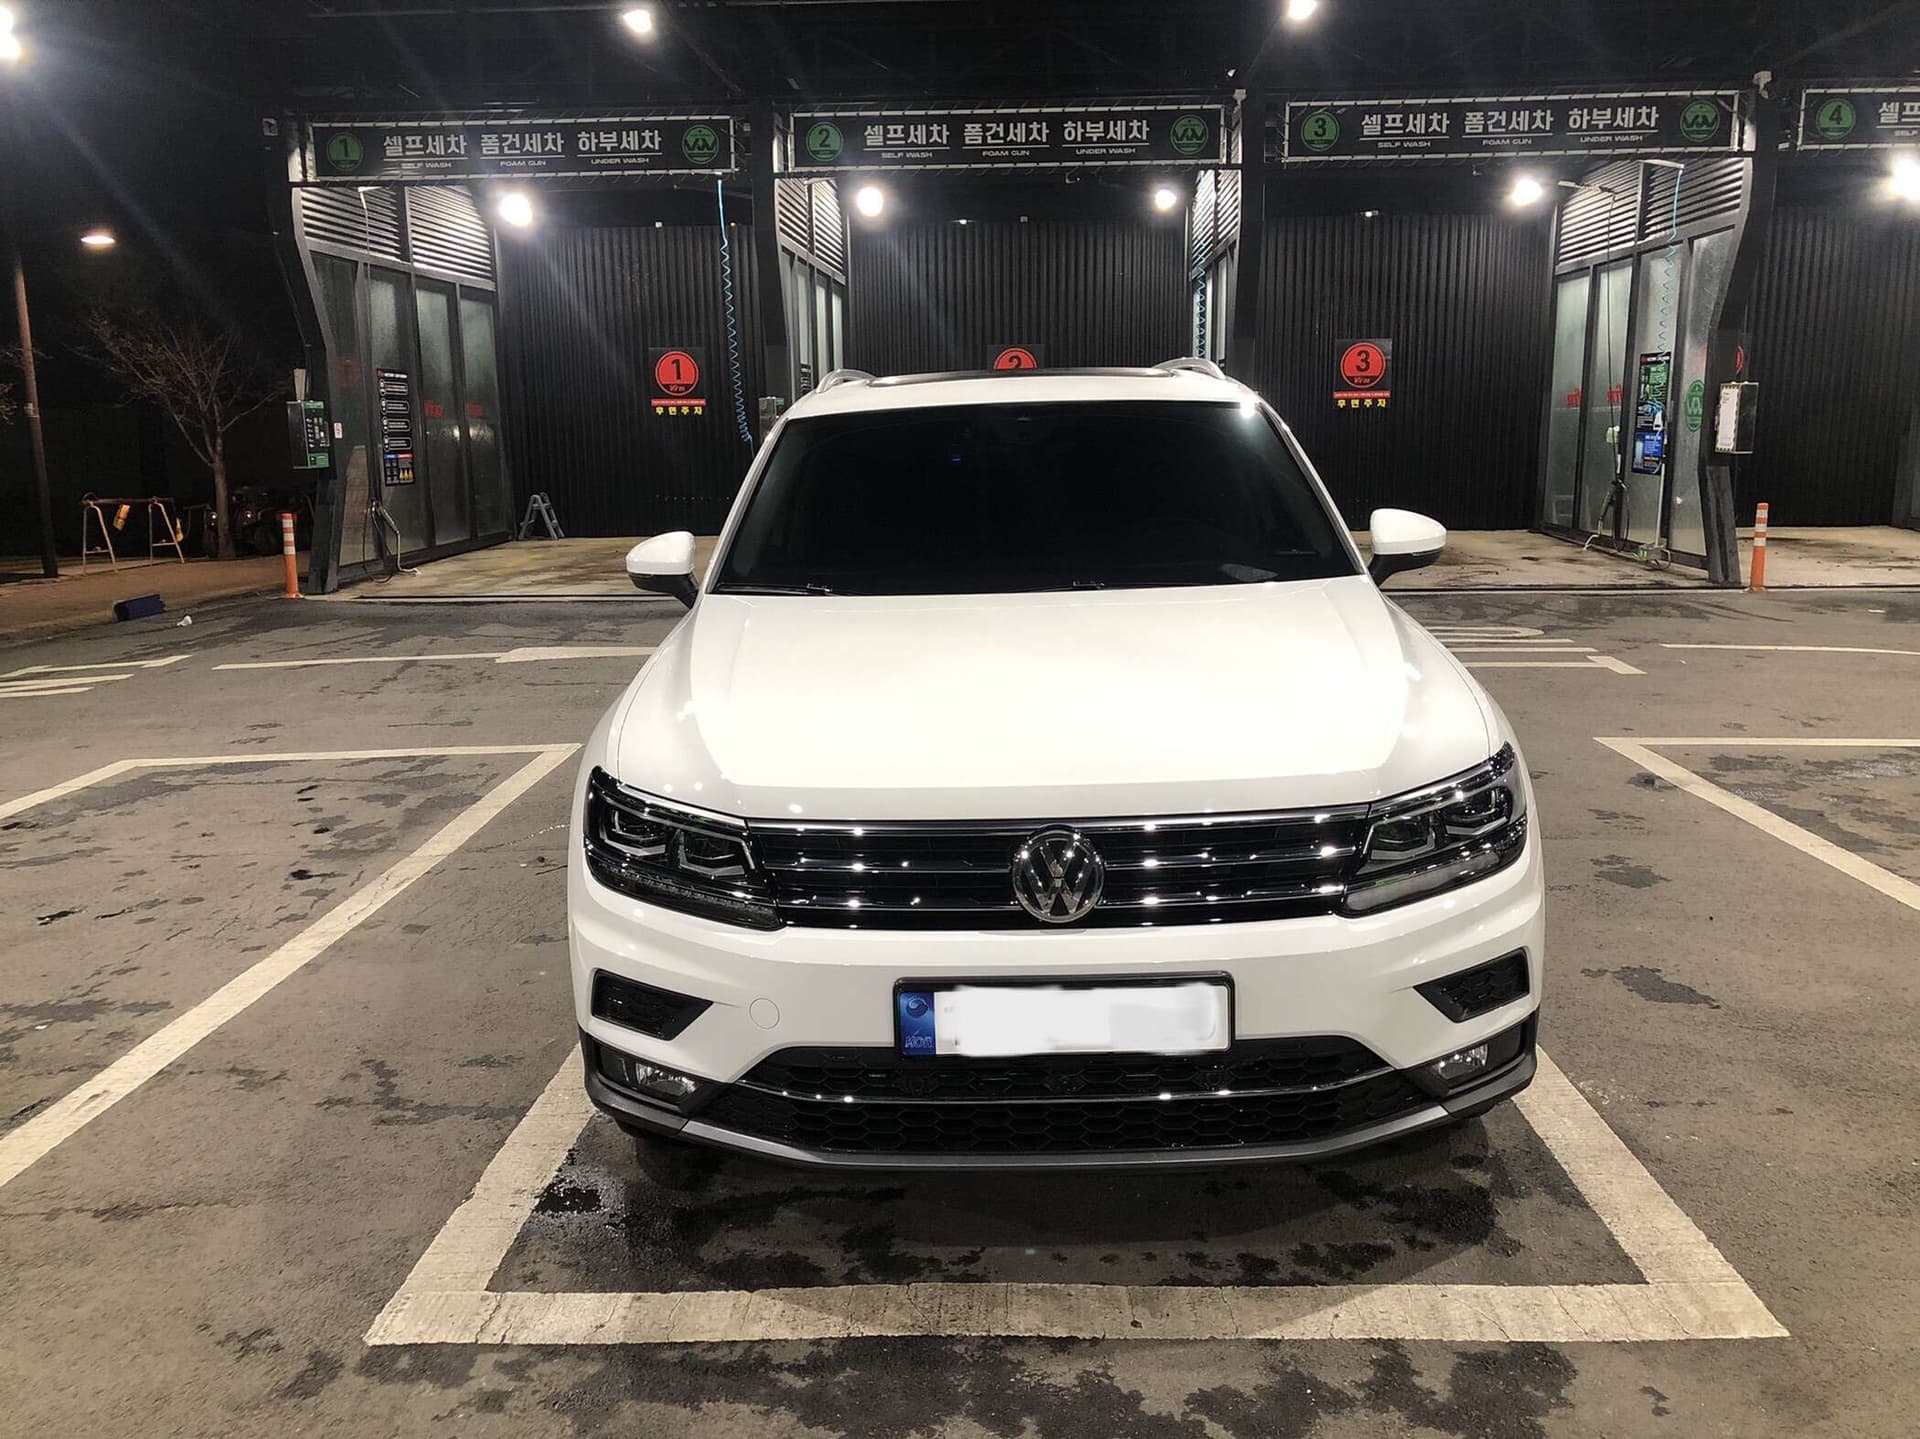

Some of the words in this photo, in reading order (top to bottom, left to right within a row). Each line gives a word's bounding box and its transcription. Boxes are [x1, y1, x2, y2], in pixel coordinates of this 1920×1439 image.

[1361, 112, 1450, 136] 셀프세차
[1464, 110, 1553, 133] 폼건세차
[1568, 106, 1659, 129] 하부세차
[1829, 104, 1843, 125] 4
[863, 123, 950, 146] 셀프세차
[963, 121, 1050, 144] 폼건세차
[1062, 118, 1150, 141] 하부세차
[1314, 117, 1327, 137] 3
[339, 138, 348, 157] 1
[384, 134, 467, 156] 셀프세차
[480, 132, 565, 154] 폼건세차
[577, 129, 662, 151] 하부세차
[818, 128, 831, 148] 2
[1482, 138, 1510, 146] FOAM
[671, 358, 681, 380] 1
[1355, 349, 1370, 371] 3
